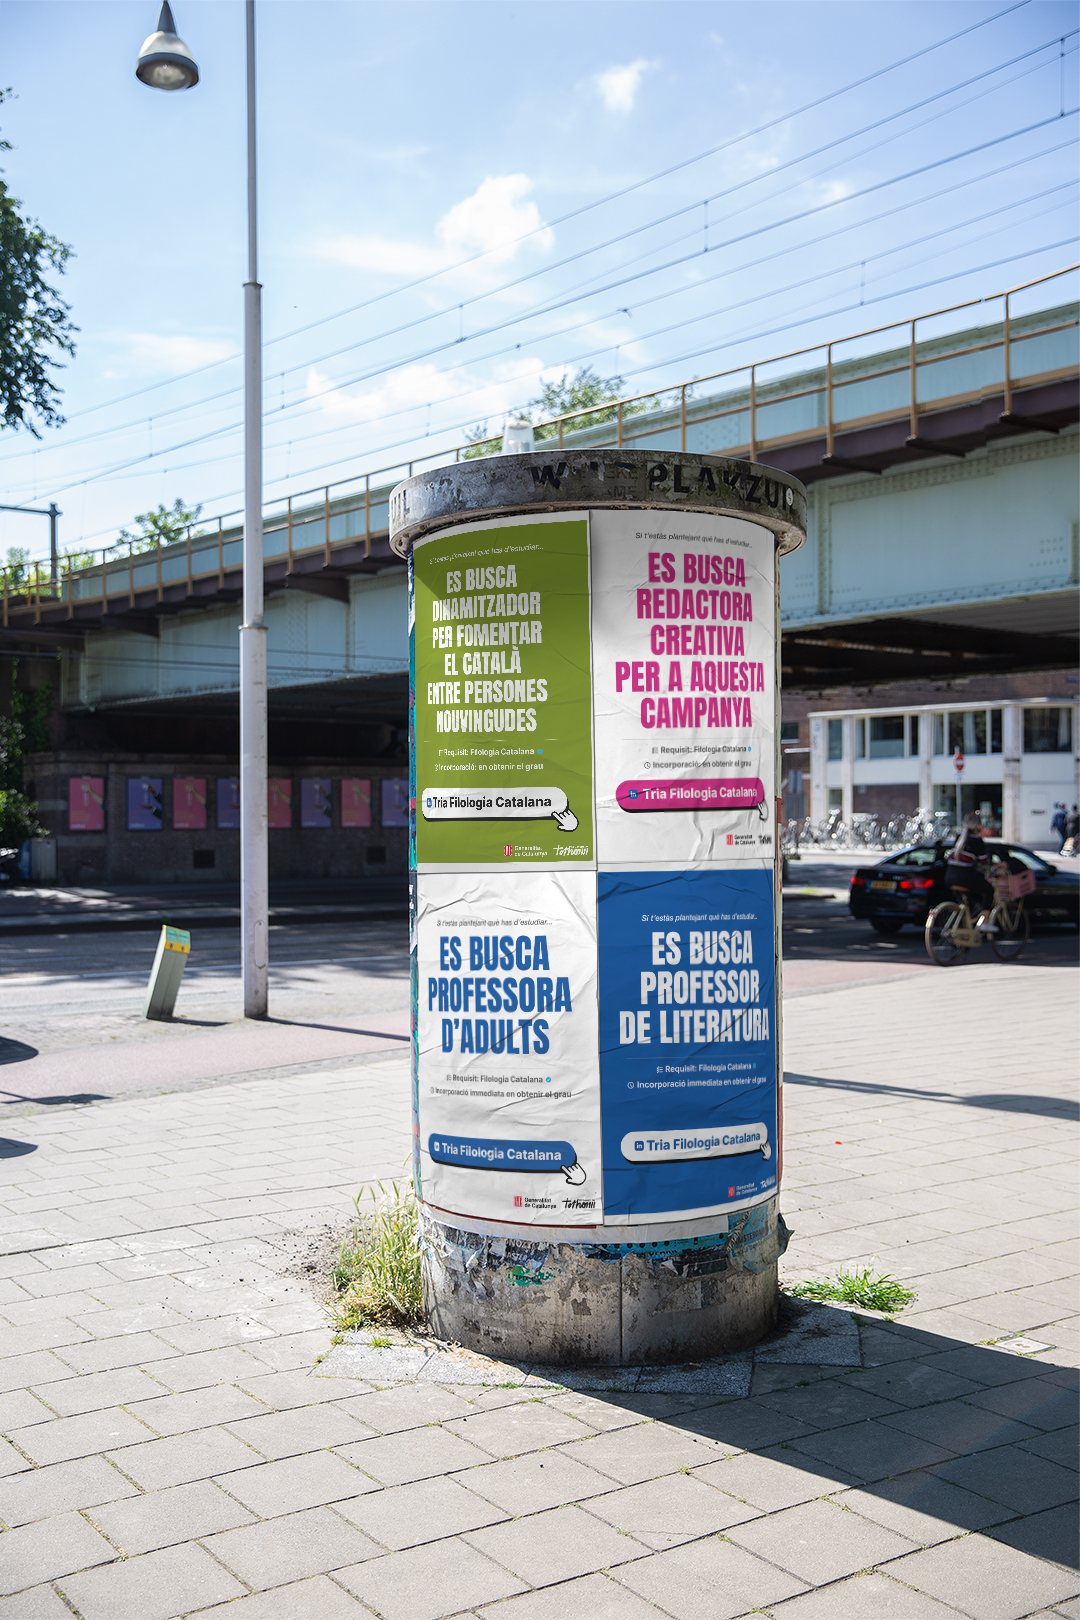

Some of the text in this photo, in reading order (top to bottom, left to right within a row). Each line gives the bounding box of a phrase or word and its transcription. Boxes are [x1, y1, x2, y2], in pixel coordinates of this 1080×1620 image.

[635, 531, 643, 539] Si
[668, 533, 701, 542] plantejant
[713, 536, 725, 544] has
[446, 564, 517, 593] ES BUSCA
[648, 552, 746, 587] ES BUSCA
[432, 591, 541, 622] DINAMITZADOR
[636, 588, 753, 622] REDACTORA
[432, 620, 543, 648] PER FOMENTAR
[650, 624, 745, 657] CREATIVA
[444, 645, 522, 676] EL CATALÀ
[615, 661, 765, 694] PER A AQUESTA
[427, 678, 549, 704] ENTRE PERSONES
[436, 708, 537, 733] NOUVINGUDES
[640, 697, 752, 729] CAMPANYA
[500, 747, 535, 756] Catalana
[660, 745, 747, 755] Requisit: Filologia Catalana
[488, 763, 515, 771] obtenir
[525, 763, 544, 772] grau
[711, 760, 734, 768] obtenir
[432, 796, 448, 809] Tria
[449, 796, 493, 811] Filologia
[495, 796, 552, 808] Catalana
[642, 786, 758, 801] Tria Filologia Catalana
[458, 919, 487, 928] plantejant
[650, 914, 674, 922] t'estàs
[674, 914, 707, 923] plantejant
[439, 935, 550, 971] ES BUSCA
[651, 930, 753, 966] ES BUSCA
[428, 976, 573, 1013] PROFESSORA
[640, 969, 760, 1005] PROFESSOR
[441, 1018, 550, 1055] D'ADULTS
[619, 1008, 770, 1045] DE LITERATURA
[452, 1074, 544, 1084] Requisit: Filologia Catalana
[665, 1063, 751, 1075] Requisit: Filologia Catalana
[435, 1087, 469, 1097] Incorporació
[470, 1089, 505, 1097] immediata
[516, 1089, 544, 1098] obtenir
[553, 1090, 572, 1099] grau
[636, 1080, 686, 1090] Incorporació
[687, 1078, 723, 1087] immediata
[441, 1142, 459, 1156] Tria
[460, 1145, 504, 1161] Filologia
[506, 1149, 562, 1161] Catalana
[646, 1131, 761, 1151] Tria Filologia Catalana
